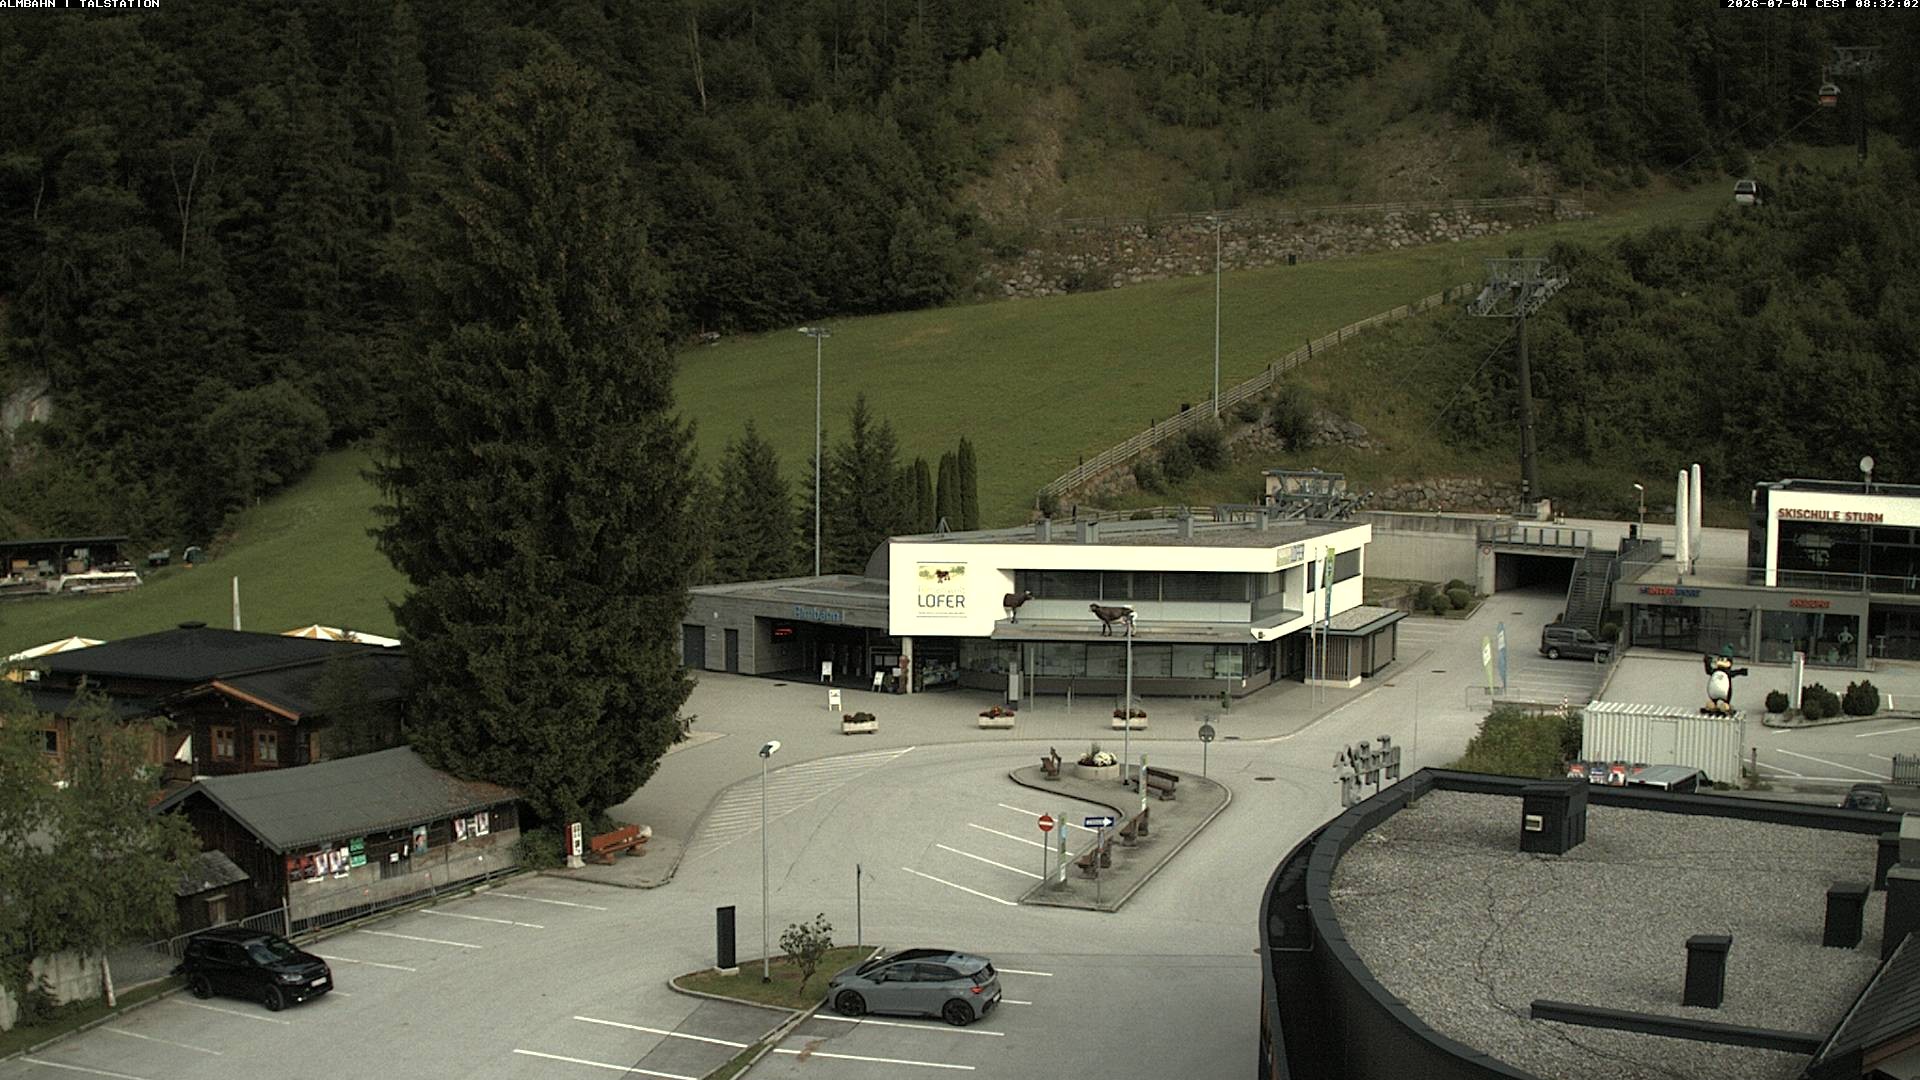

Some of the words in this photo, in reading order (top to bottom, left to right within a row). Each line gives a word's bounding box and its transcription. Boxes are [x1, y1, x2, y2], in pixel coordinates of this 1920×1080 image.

[1777, 507, 1840, 521] SKISCHULE
[1845, 511, 1884, 523] STURM
[917, 593, 966, 609] LOFER
